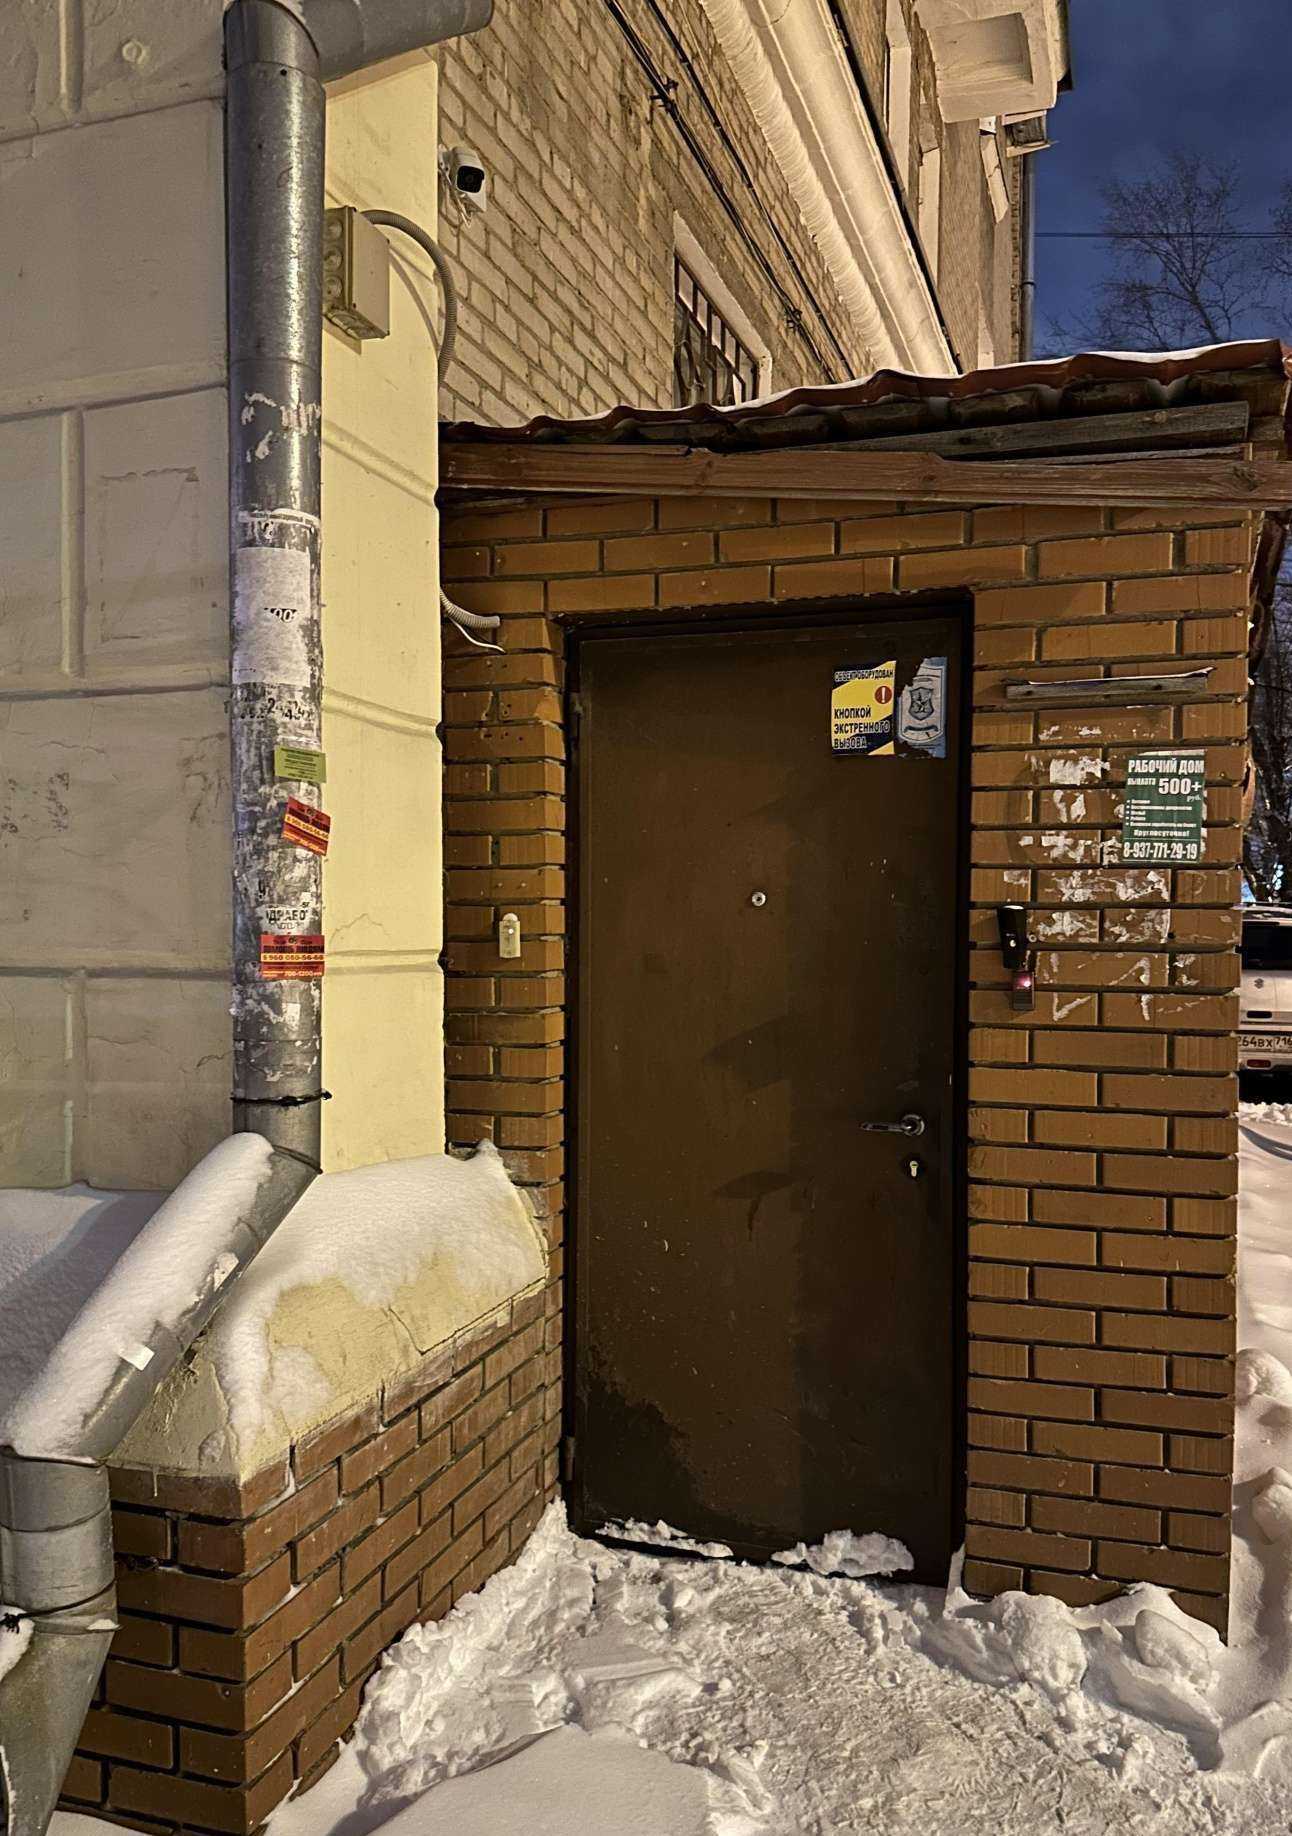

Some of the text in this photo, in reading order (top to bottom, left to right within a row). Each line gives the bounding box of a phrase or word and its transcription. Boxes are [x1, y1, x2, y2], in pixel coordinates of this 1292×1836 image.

[857, 669, 894, 681] ОБОРУДОВАН
[834, 704, 872, 719] КНОПКОЙ
[834, 720, 891, 735] ЭКСТРЕННОГО
[834, 736, 867, 750] ВЫЗОВА
[1128, 758, 1205, 775] РАБОЧИЙ ДОМ
[1158, 777, 1202, 795] 500+
[1123, 841, 1198, 860] 8-937-771-29-19
